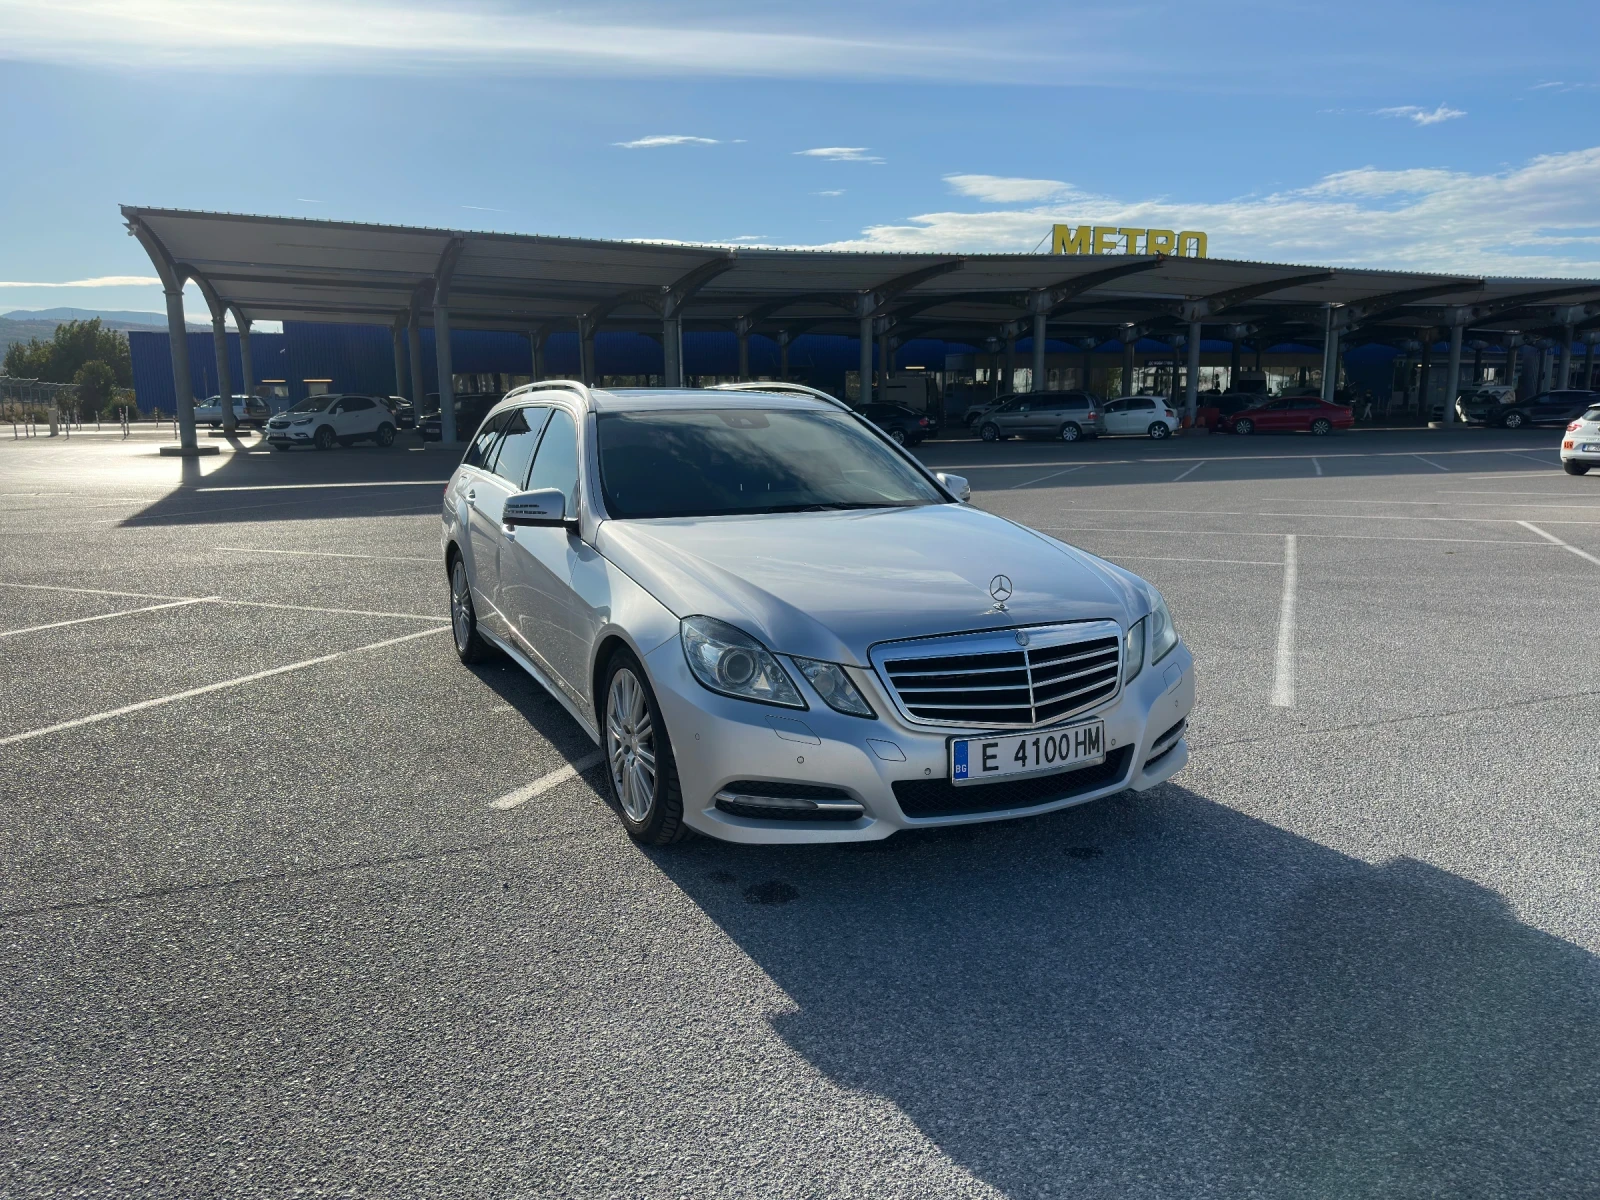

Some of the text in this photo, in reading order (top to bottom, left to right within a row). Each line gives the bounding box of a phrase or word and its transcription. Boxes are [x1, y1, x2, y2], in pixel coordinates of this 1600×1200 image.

[1053, 224, 1207, 258] METRO
[982, 726, 1100, 772] E 4100 HM
[955, 764, 967, 773] BG
